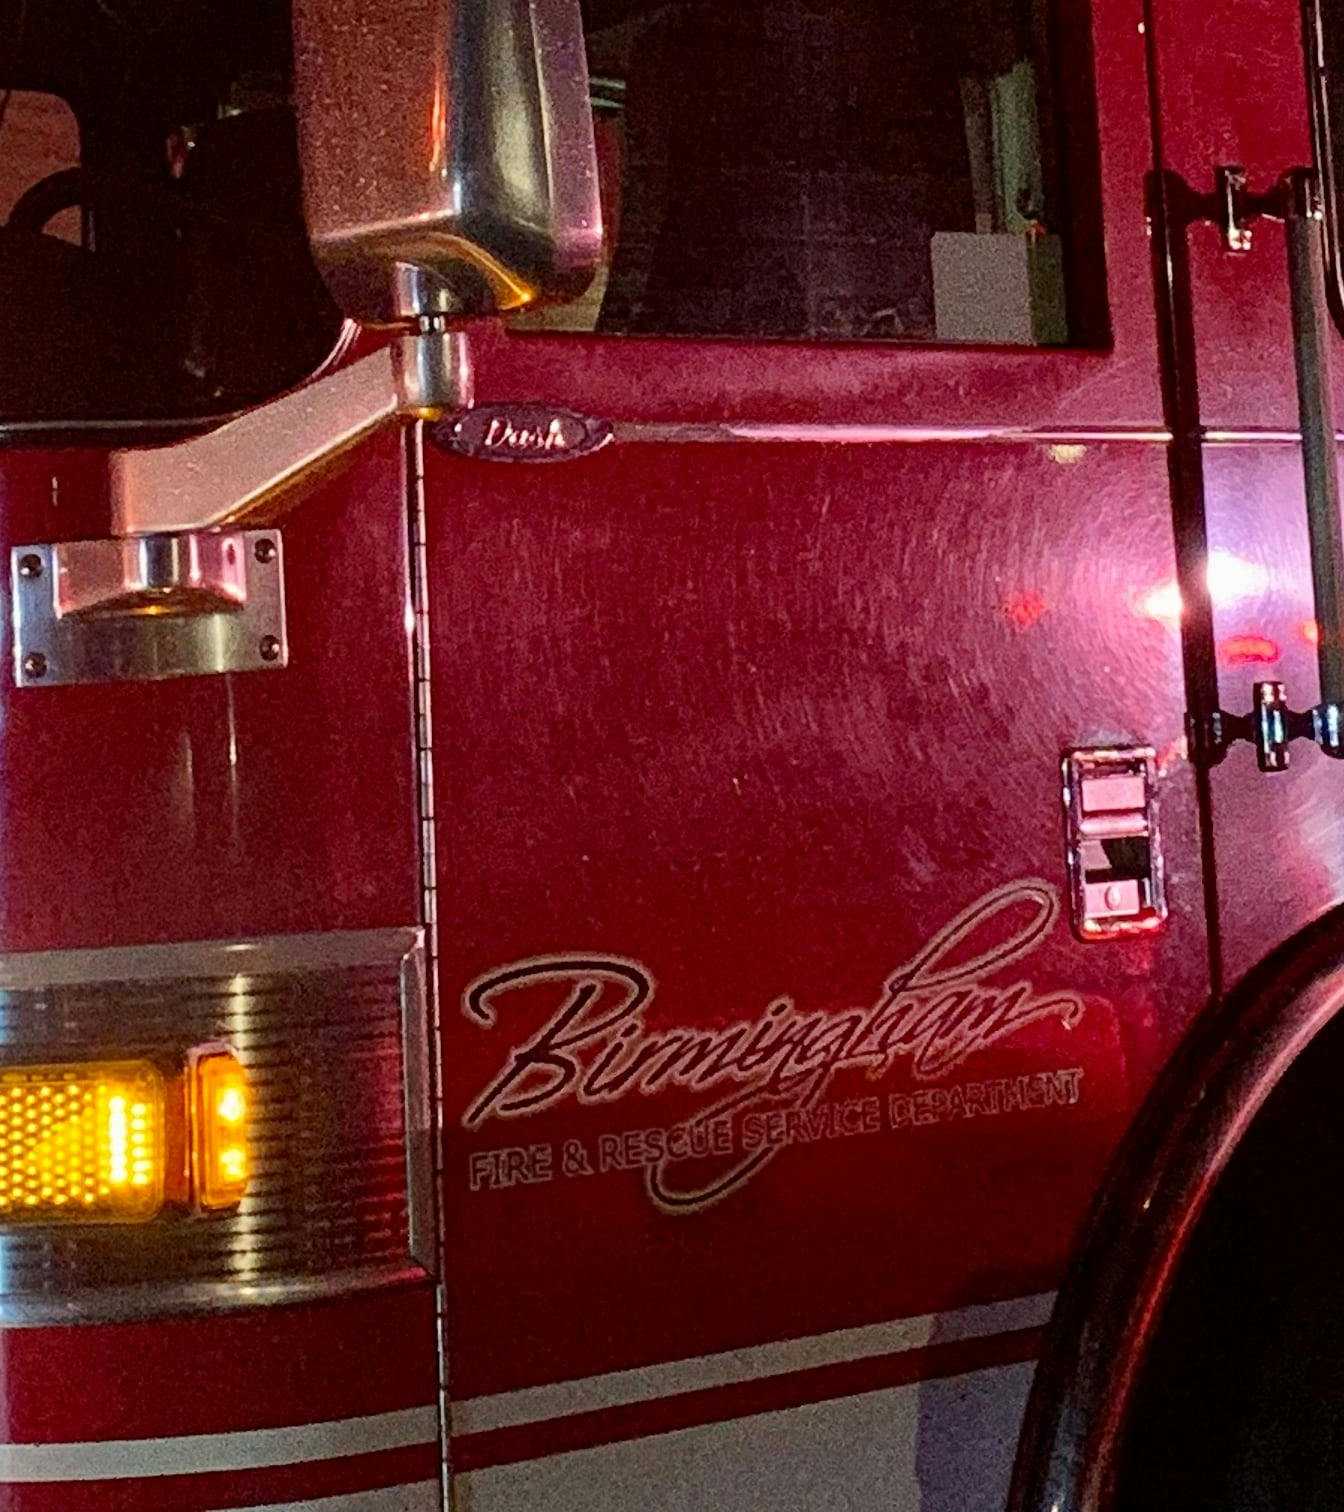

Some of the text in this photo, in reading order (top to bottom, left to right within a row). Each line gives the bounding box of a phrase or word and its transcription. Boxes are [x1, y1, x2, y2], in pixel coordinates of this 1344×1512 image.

[460, 878, 1085, 1216] Birmingham
[468, 1065, 1085, 1192] FIRE & RESCUE SERVICE DEPARTMENT
